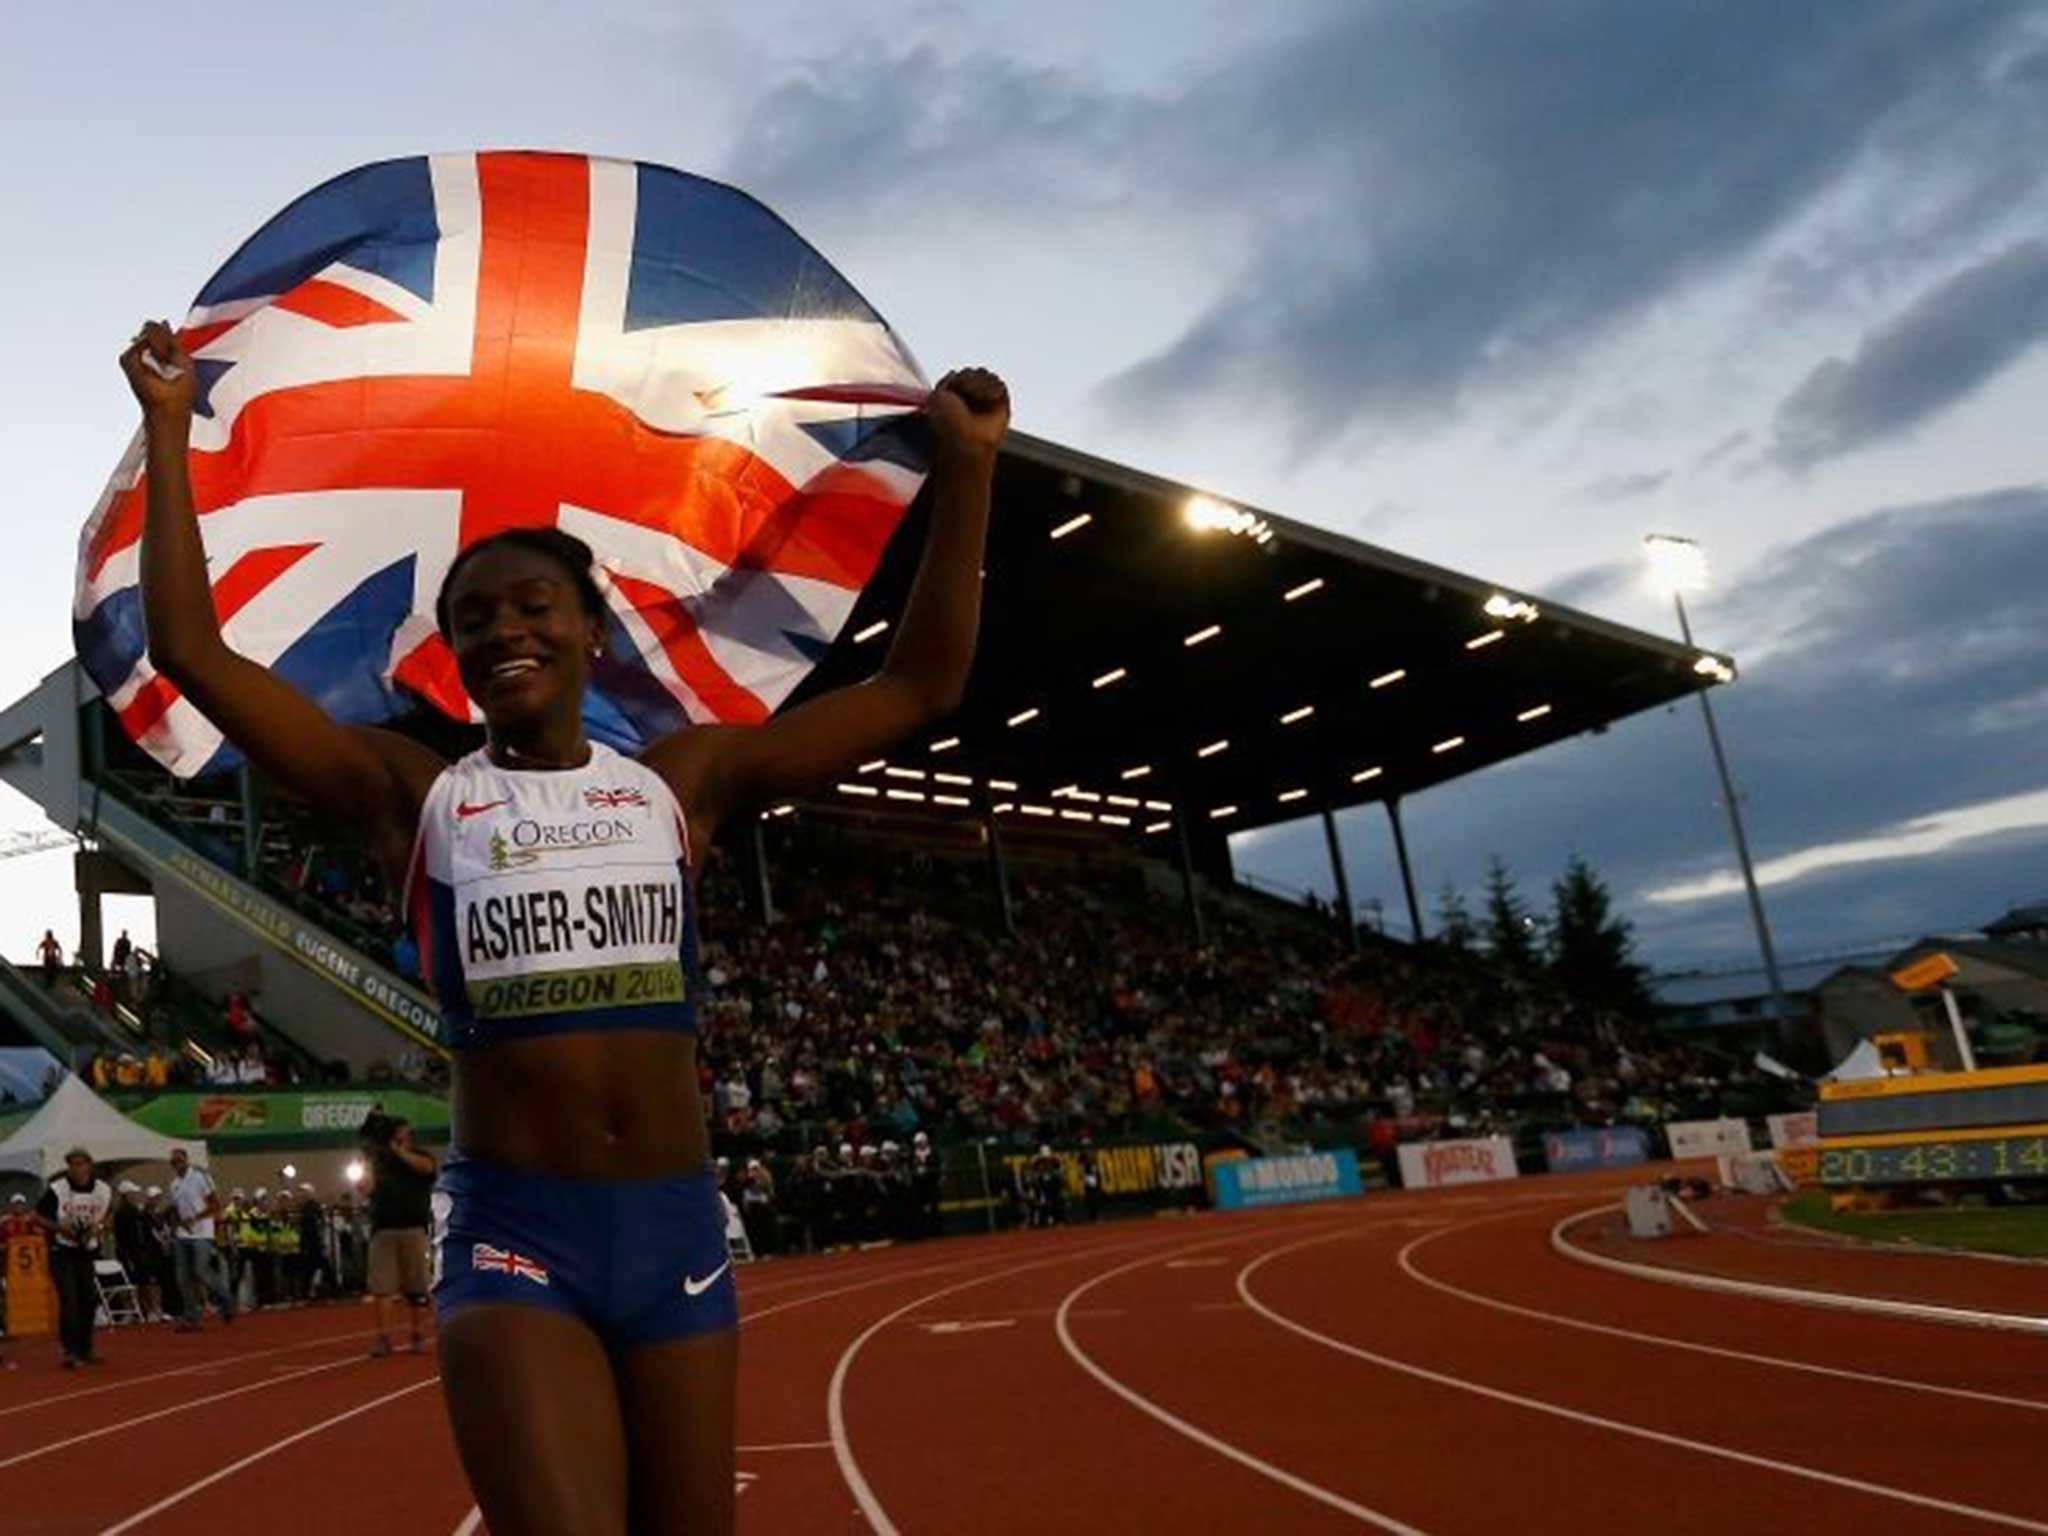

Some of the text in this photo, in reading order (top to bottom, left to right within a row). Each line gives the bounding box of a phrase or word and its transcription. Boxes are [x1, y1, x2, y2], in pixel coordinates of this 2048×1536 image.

[513, 819, 633, 847] OREGON
[468, 883, 677, 964] ASHER-SMITH
[295, 931, 361, 985] EUGENE
[364, 977, 439, 1037] OREGON
[485, 976, 617, 1012] OREGON
